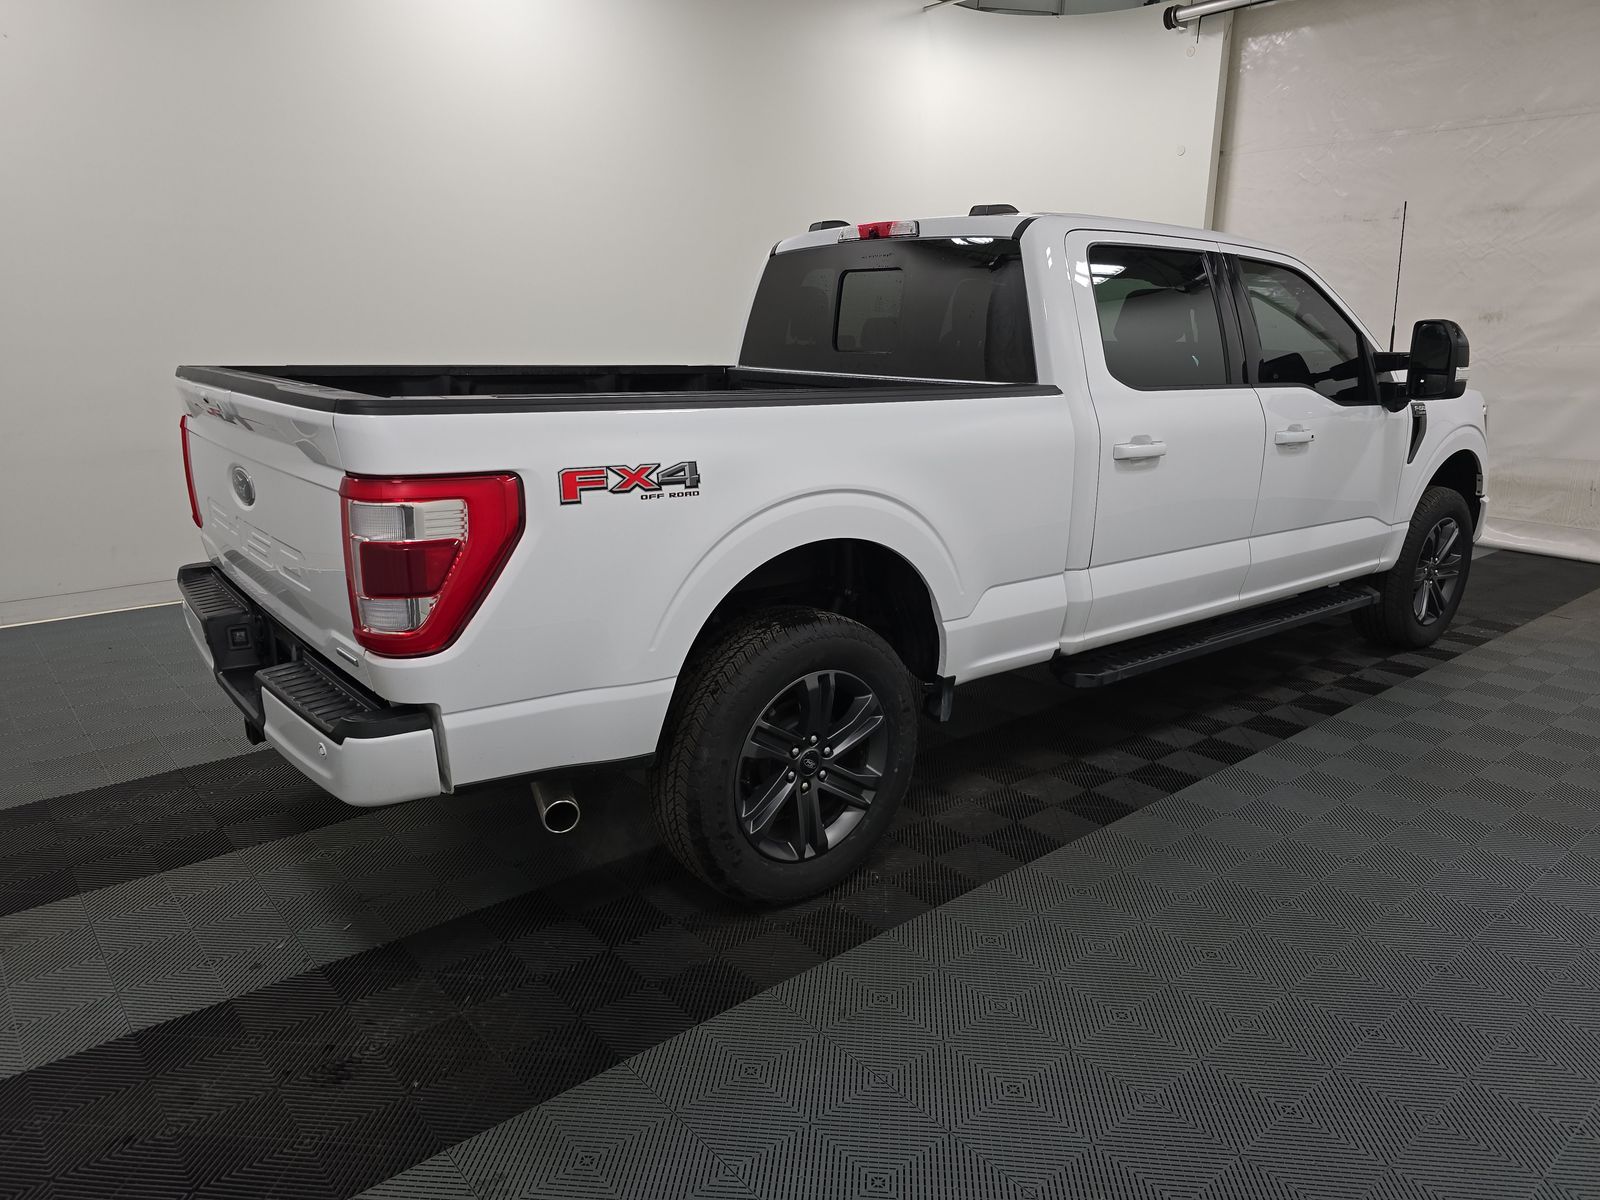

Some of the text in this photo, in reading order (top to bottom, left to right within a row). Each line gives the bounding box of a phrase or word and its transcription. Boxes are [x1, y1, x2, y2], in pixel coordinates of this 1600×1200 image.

[557, 460, 701, 506] FX4
[640, 490, 700, 501] OFF ROAD
